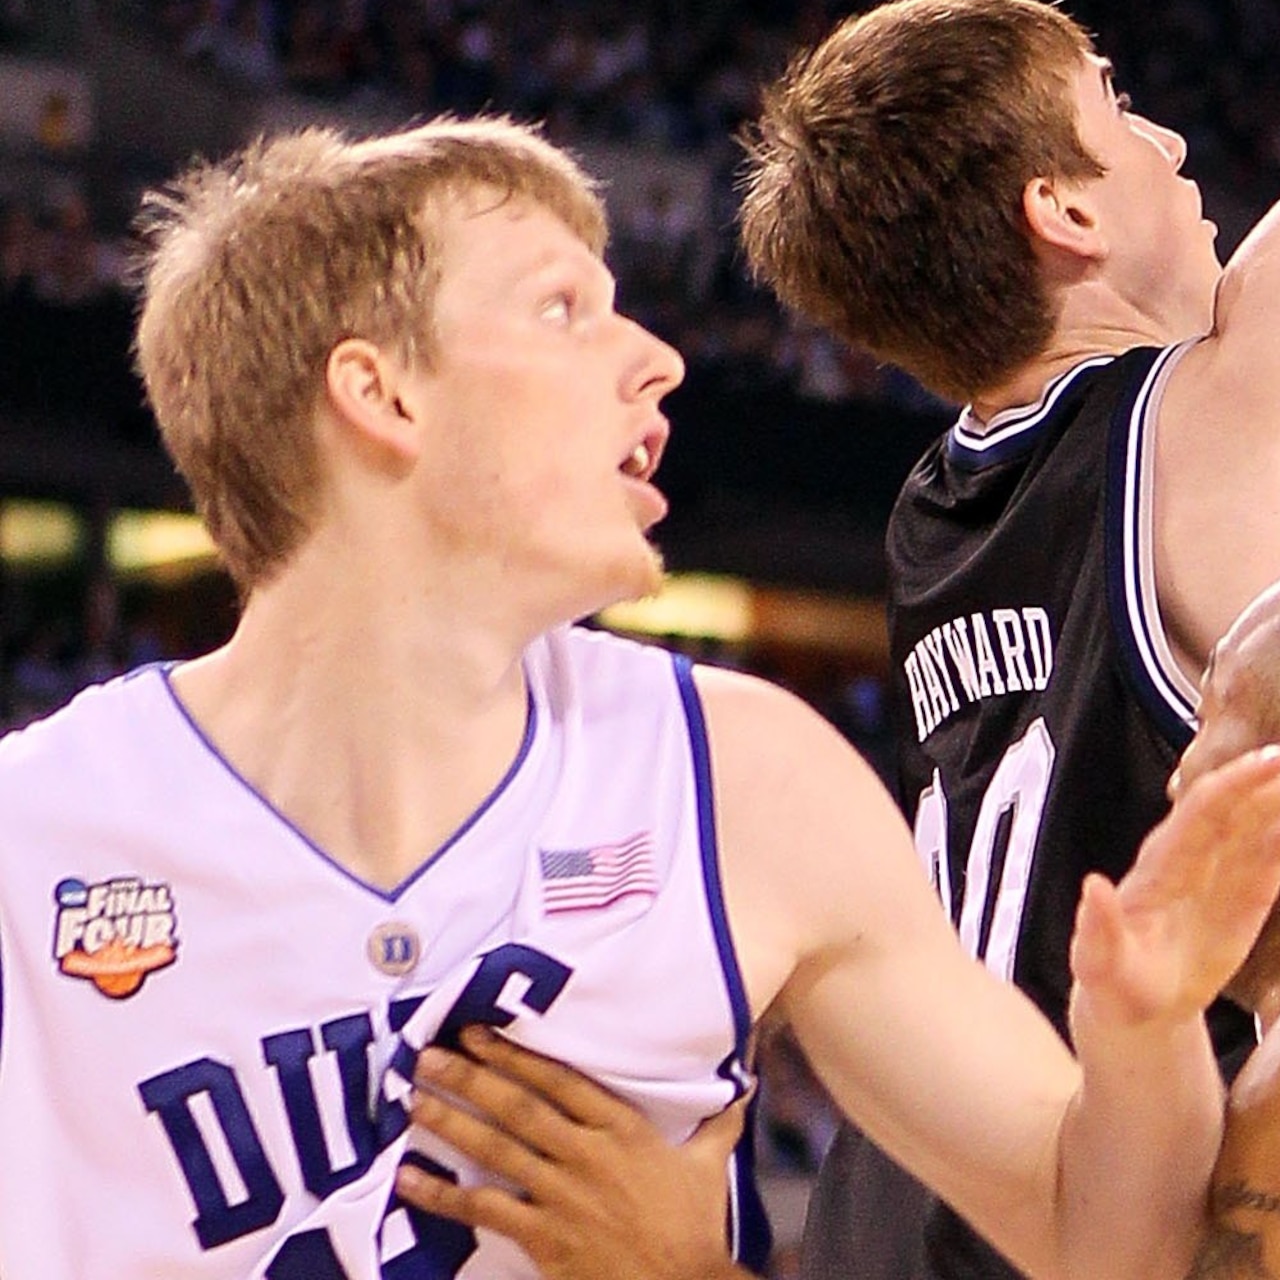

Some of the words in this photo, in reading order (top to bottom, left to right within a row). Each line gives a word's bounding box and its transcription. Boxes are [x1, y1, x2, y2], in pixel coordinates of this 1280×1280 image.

[904, 606, 1054, 744] HAYWARD
[87, 884, 174, 919] FINAL
[56, 907, 177, 959] FOUR
